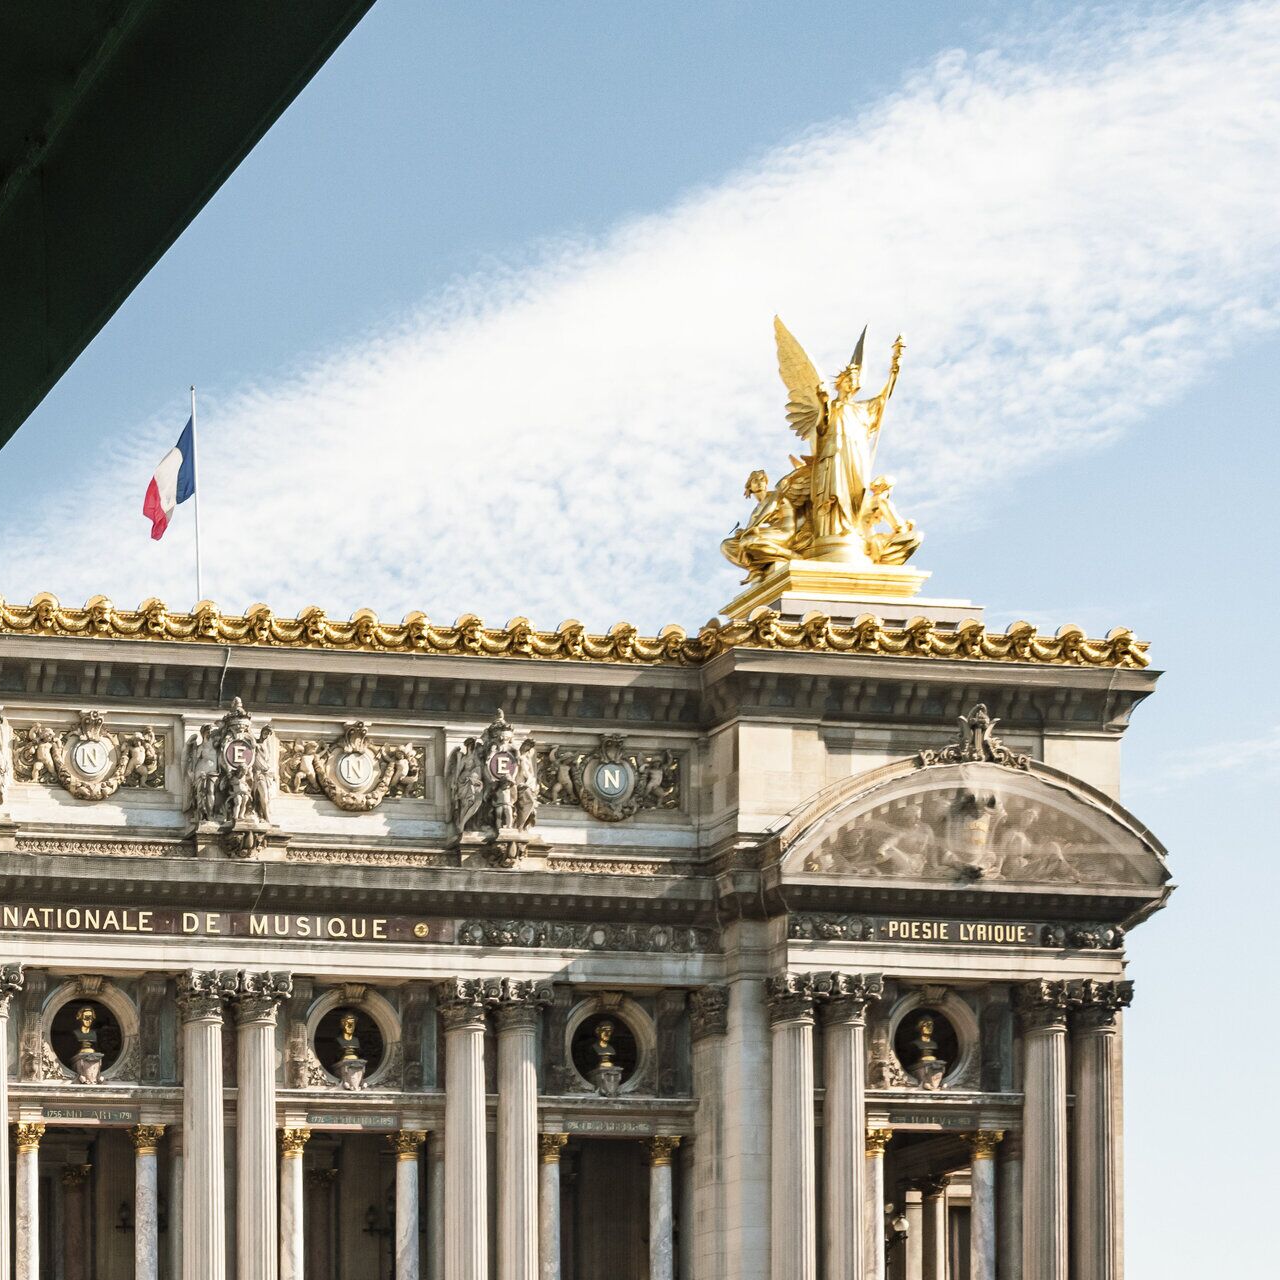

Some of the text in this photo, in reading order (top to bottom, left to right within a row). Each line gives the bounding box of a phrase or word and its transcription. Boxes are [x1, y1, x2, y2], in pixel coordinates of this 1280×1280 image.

[82, 748, 97, 768] N
[233, 746, 247, 763] E
[346, 760, 361, 779] N
[497, 757, 511, 774] E
[604, 769, 620, 789] N
[3, 906, 153, 931] NATIONALE
[182, 913, 221, 933] DE
[249, 915, 388, 939] MUSIQUE
[889, 921, 1027, 943] POESIE LYRIQUE
